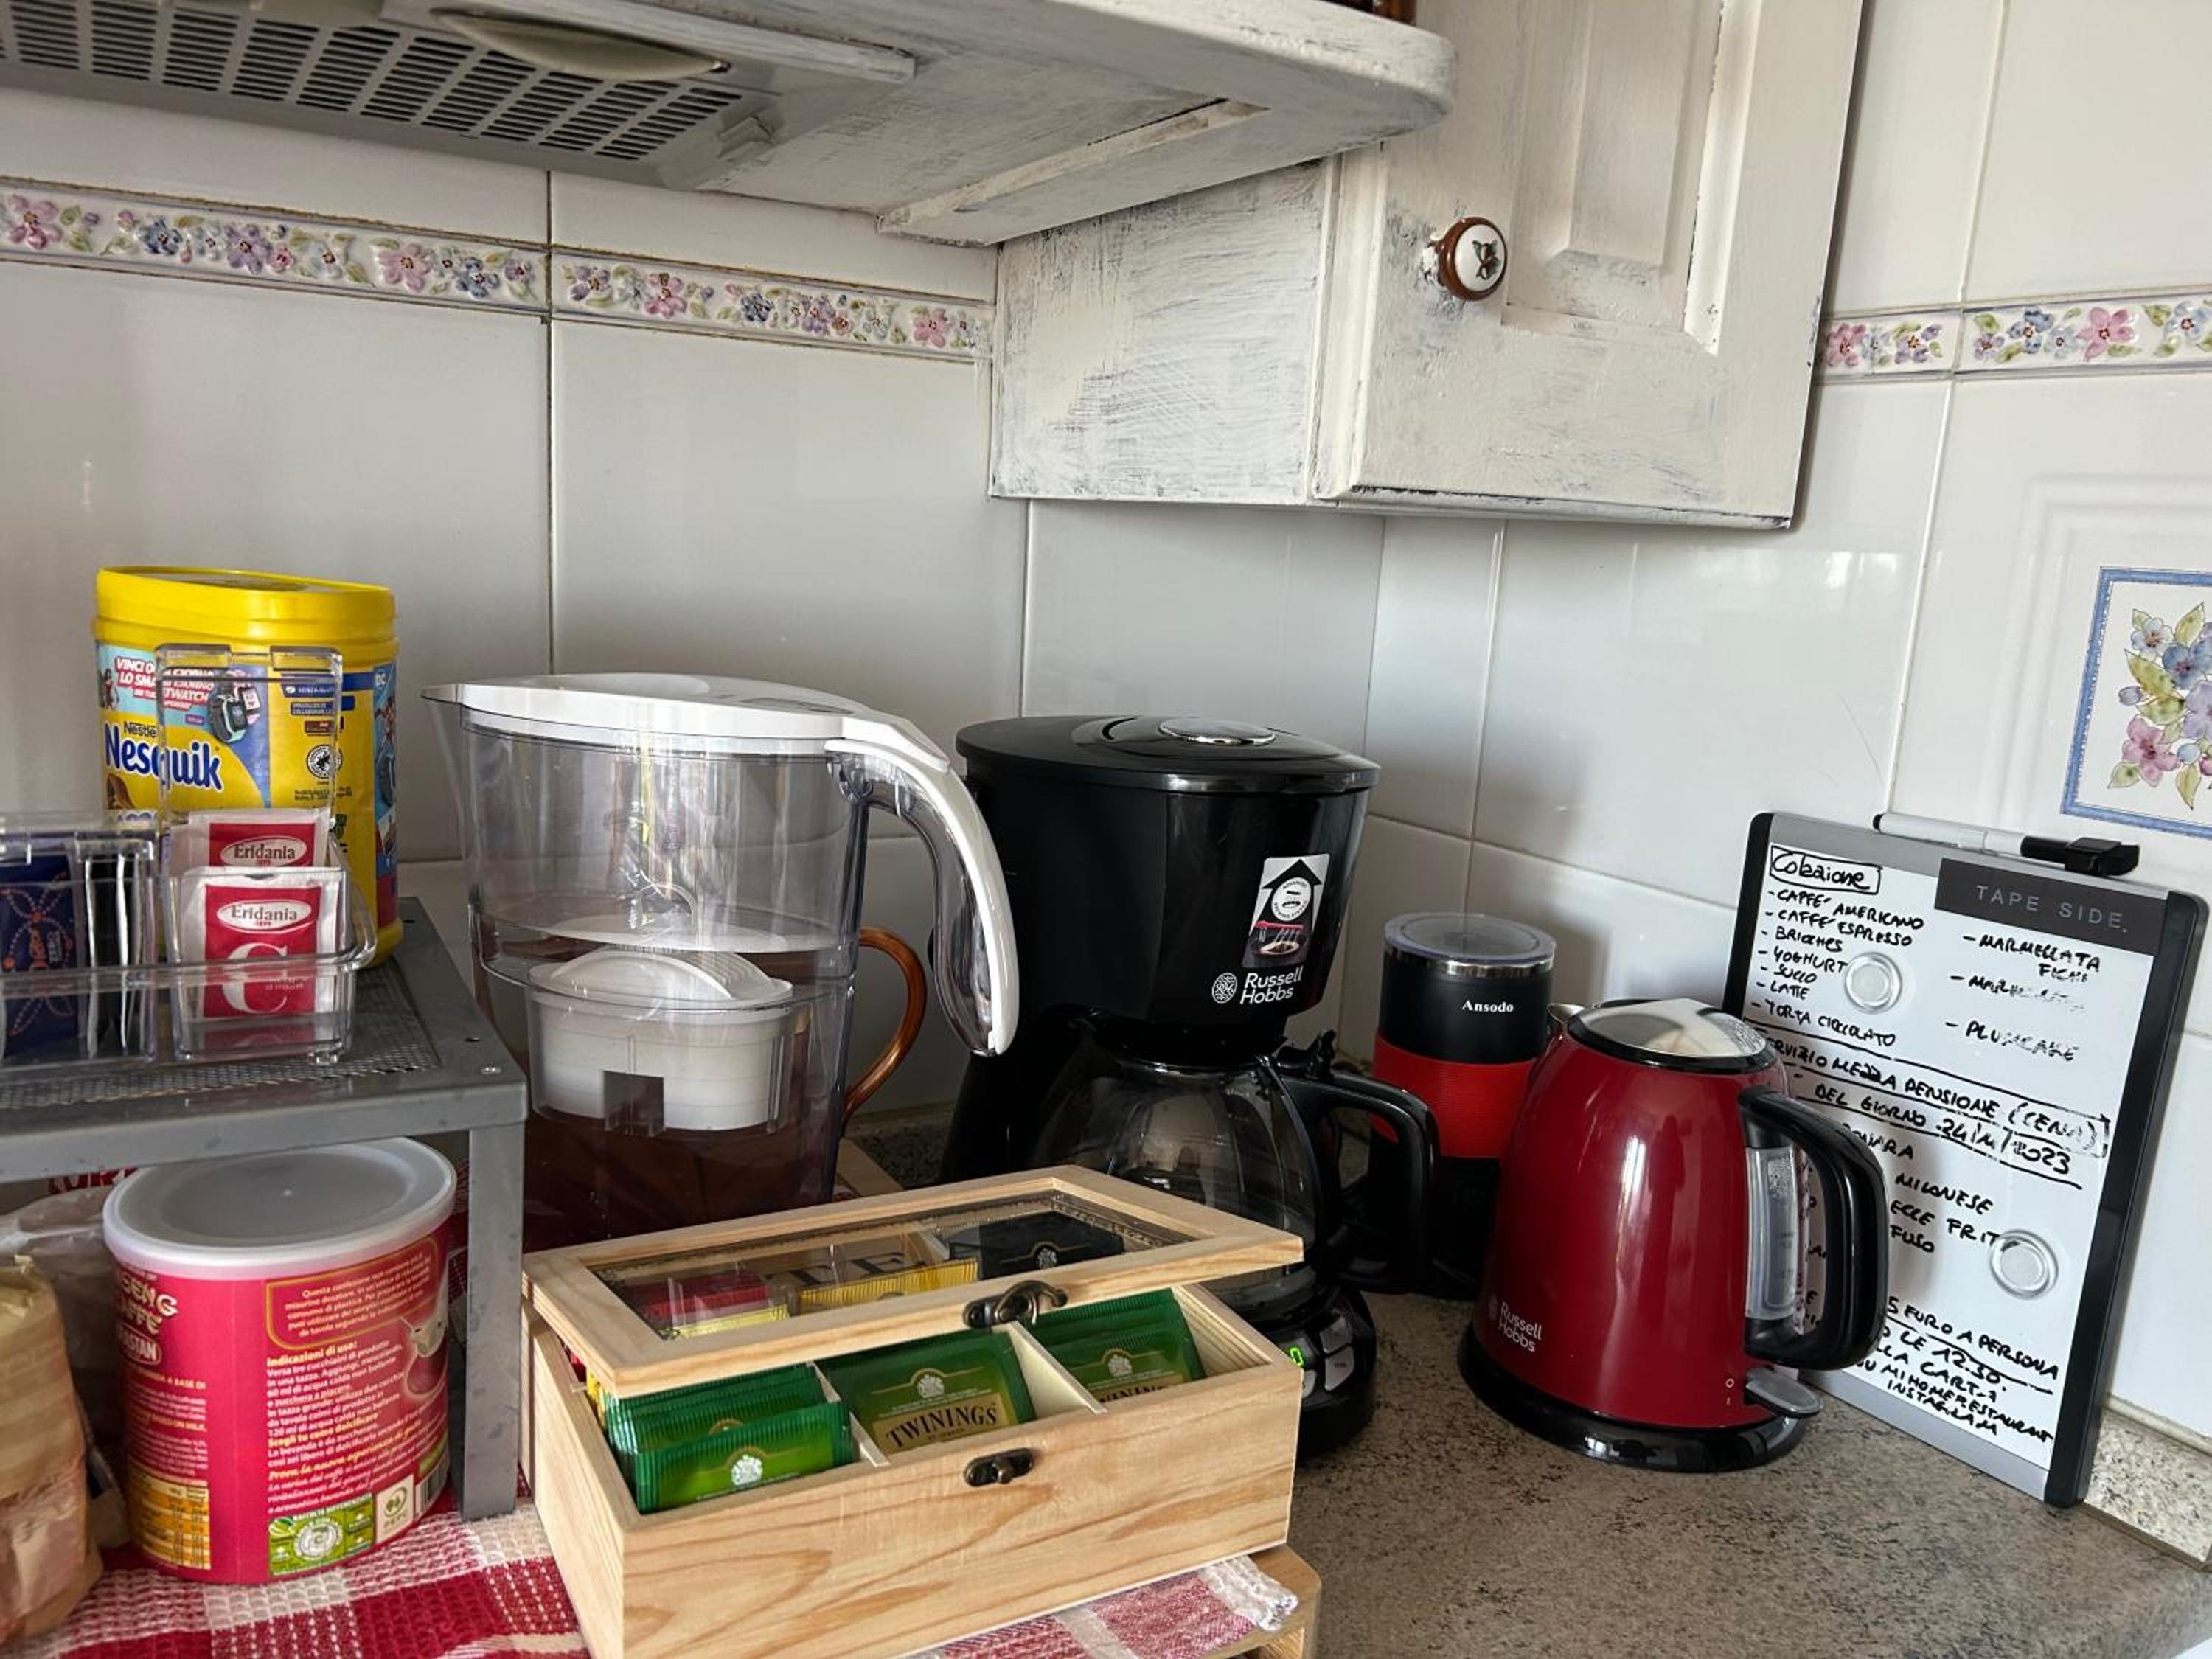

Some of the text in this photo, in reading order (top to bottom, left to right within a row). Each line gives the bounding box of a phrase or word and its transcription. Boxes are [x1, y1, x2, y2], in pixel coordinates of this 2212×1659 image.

[120, 672, 133, 684] LO
[104, 723, 223, 791] Nesquik
[234, 844, 295, 860] Eridania
[231, 904, 298, 922] Eridania
[1832, 903, 1924, 930] AMERICANO
[1975, 885, 2129, 933] TAPE SIDE.
[1837, 921, 1912, 946] ESPRESSO
[1773, 945, 1848, 973] YOGHURT
[1244, 965, 1304, 990] Russell
[1773, 963, 1817, 984] SUCCO
[1239, 986, 1294, 1005] Hobbs
[1770, 980, 1810, 1001] LATTE
[1462, 999, 1514, 1012] Ansodo
[1764, 998, 1812, 1026] TORTA
[1768, 1038, 1828, 1068] RVIZIO
[1904, 1077, 2000, 1119] PENSIONE
[1815, 1083, 1848, 1107] DEL
[1861, 1096, 1927, 1128] GIORNO
[1946, 1217, 2001, 1245] FRIT
[1498, 1315, 1535, 1353] Hobbs
[1500, 1301, 1543, 1341] Russell
[1956, 1329, 1973, 1343] A
[1978, 1334, 2059, 1380] PERSONA
[1919, 1361, 1997, 1403] CARTA
[886, 1403, 997, 1448] TWININGS
